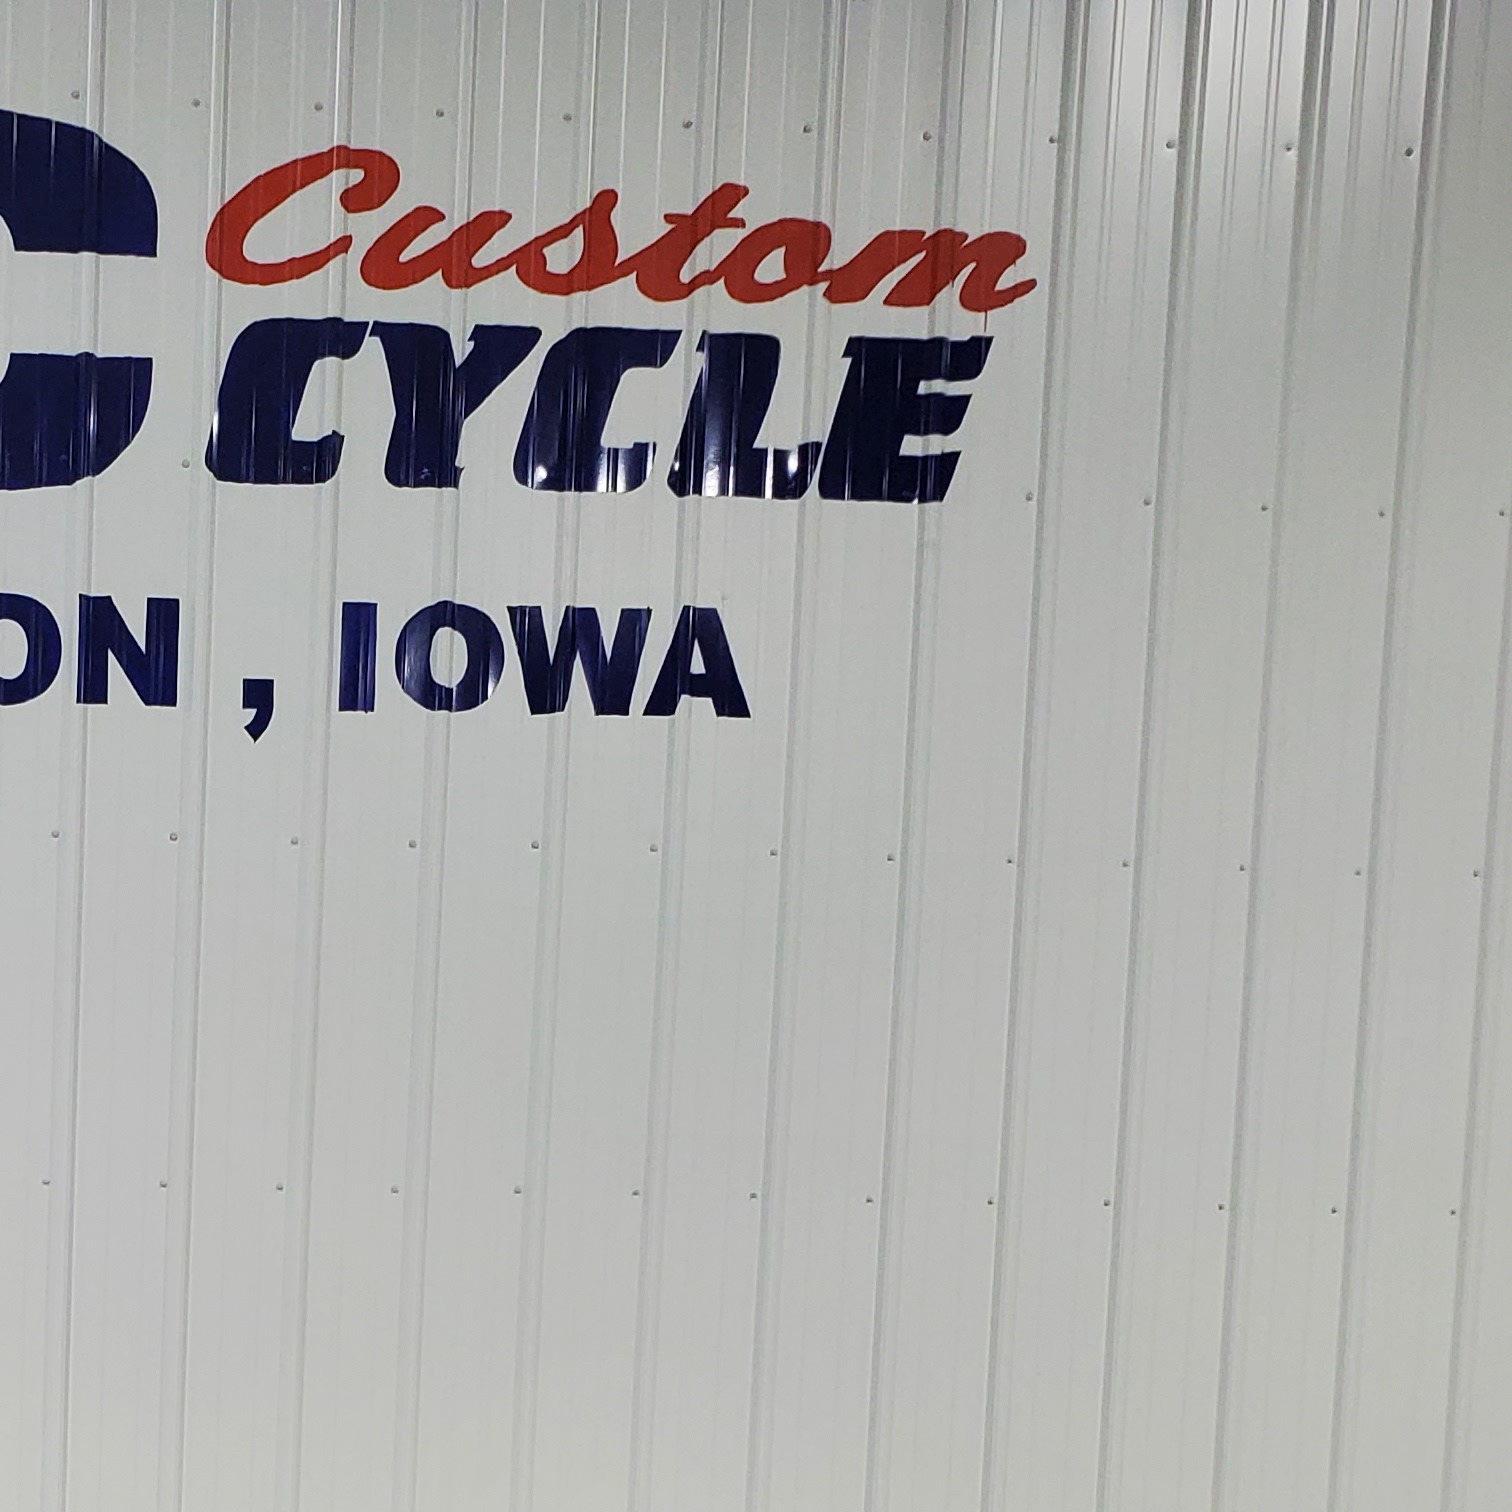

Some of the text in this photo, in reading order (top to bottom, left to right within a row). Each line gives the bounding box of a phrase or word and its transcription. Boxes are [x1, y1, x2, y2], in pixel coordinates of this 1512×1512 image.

[205, 145, 1037, 312] Custom
[204, 317, 994, 504] CYCLE
[338, 599, 752, 719] IOWA
